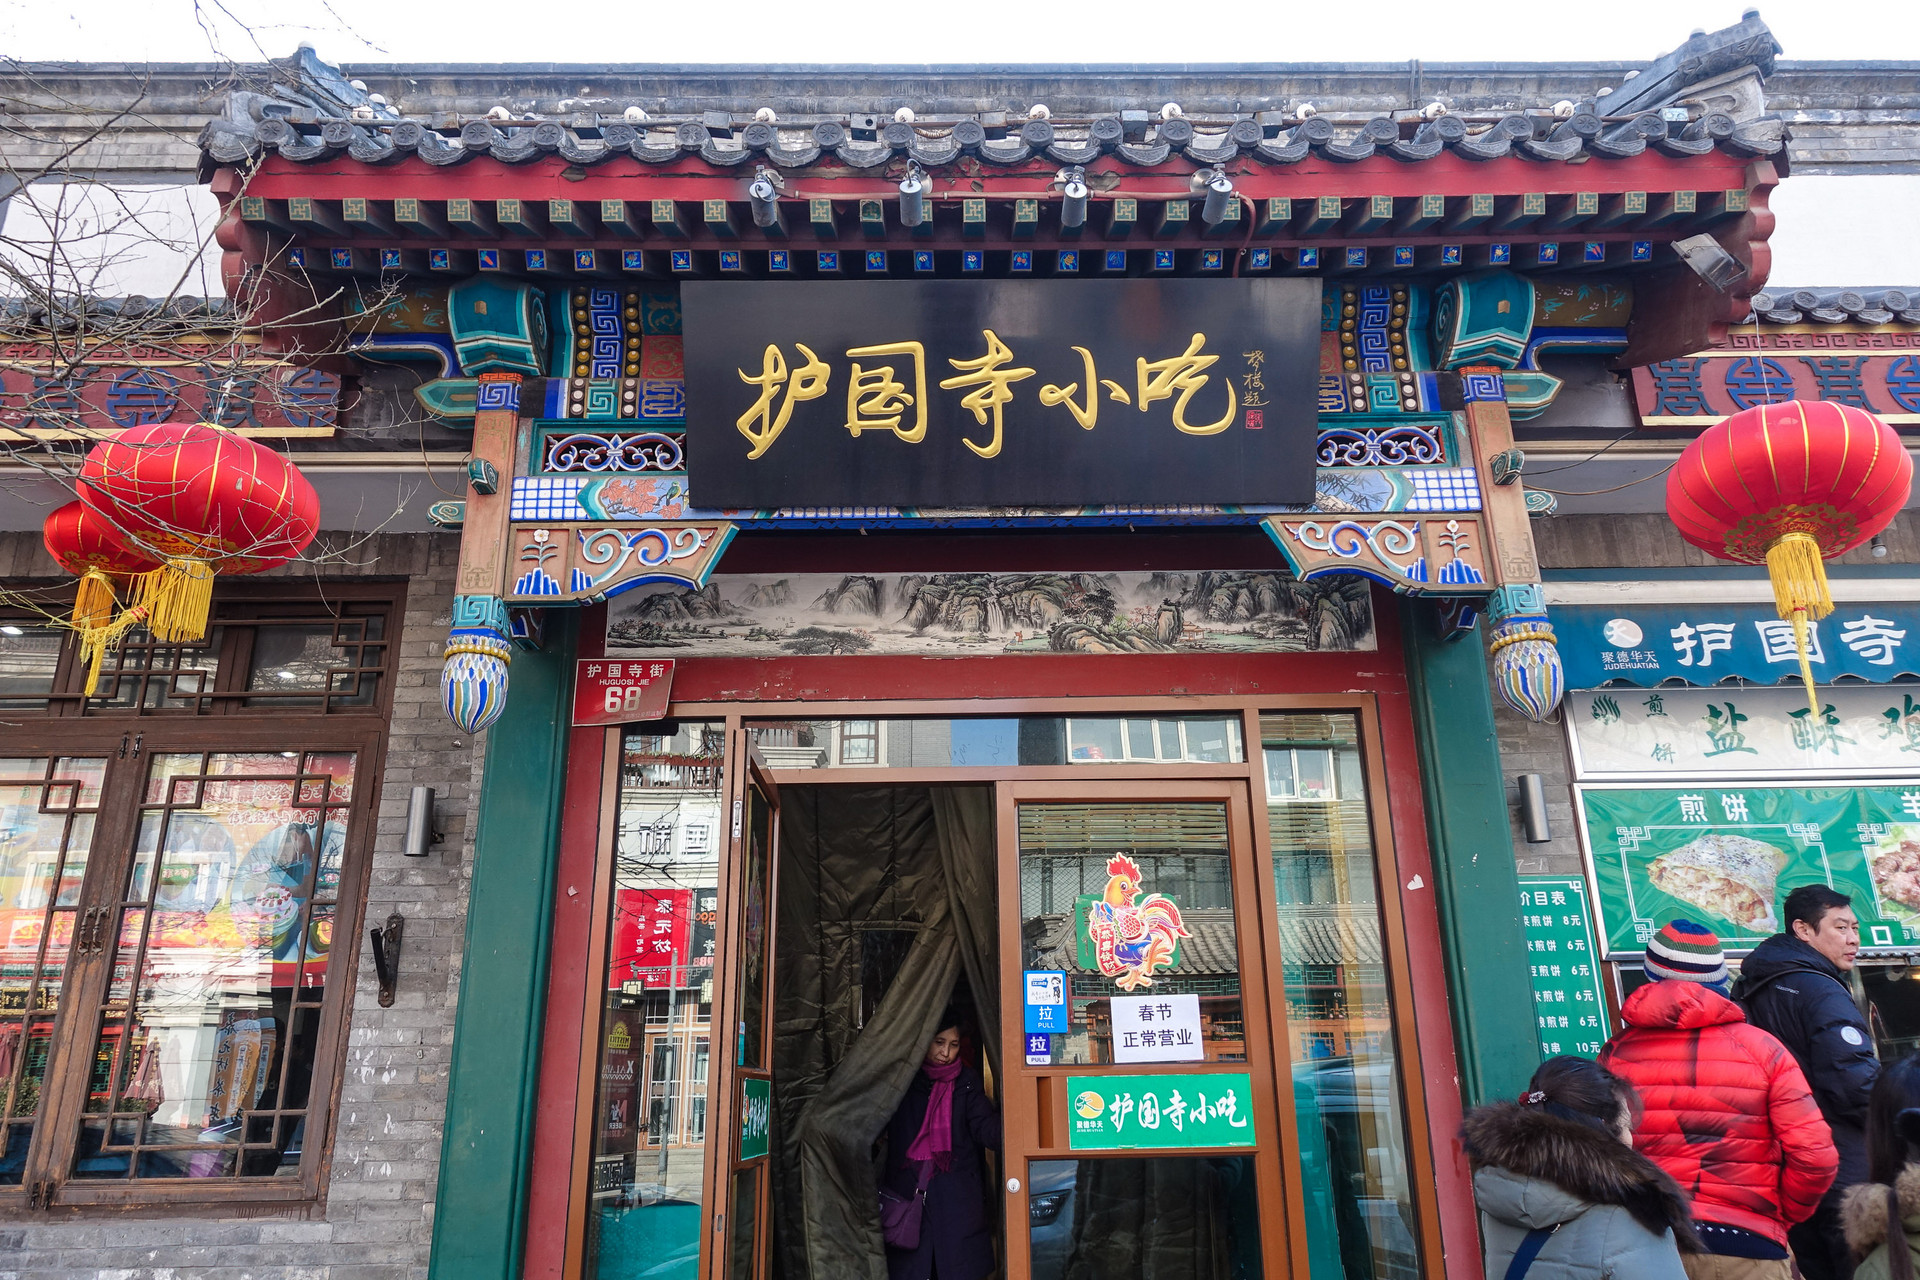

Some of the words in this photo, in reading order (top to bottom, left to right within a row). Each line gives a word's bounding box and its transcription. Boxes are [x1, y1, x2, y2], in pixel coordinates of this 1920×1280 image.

[737, 328, 1237, 460] 护国寺小吃
[1601, 650, 1658, 663] 聚德华天
[587, 664, 665, 678] 护国寺街
[1603, 662, 1660, 671] JUDEHUATIAN
[604, 686, 642, 713] 68
[1677, 794, 1749, 821] 煎饼
[1562, 915, 1581, 926] 8元
[1567, 940, 1586, 951] 6元
[1571, 965, 1590, 976] 6元
[1575, 990, 1594, 1001] 6元
[1039, 1006, 1054, 1020] 拉
[1138, 1003, 1172, 1022] 春节
[1579, 1016, 1598, 1027] 6元
[1030, 1036, 1047, 1052] 拉
[1123, 1028, 1194, 1048] 正常营业
[1576, 1042, 1601, 1053] 10元
[1108, 1089, 1248, 1133] 护国寺小吃
